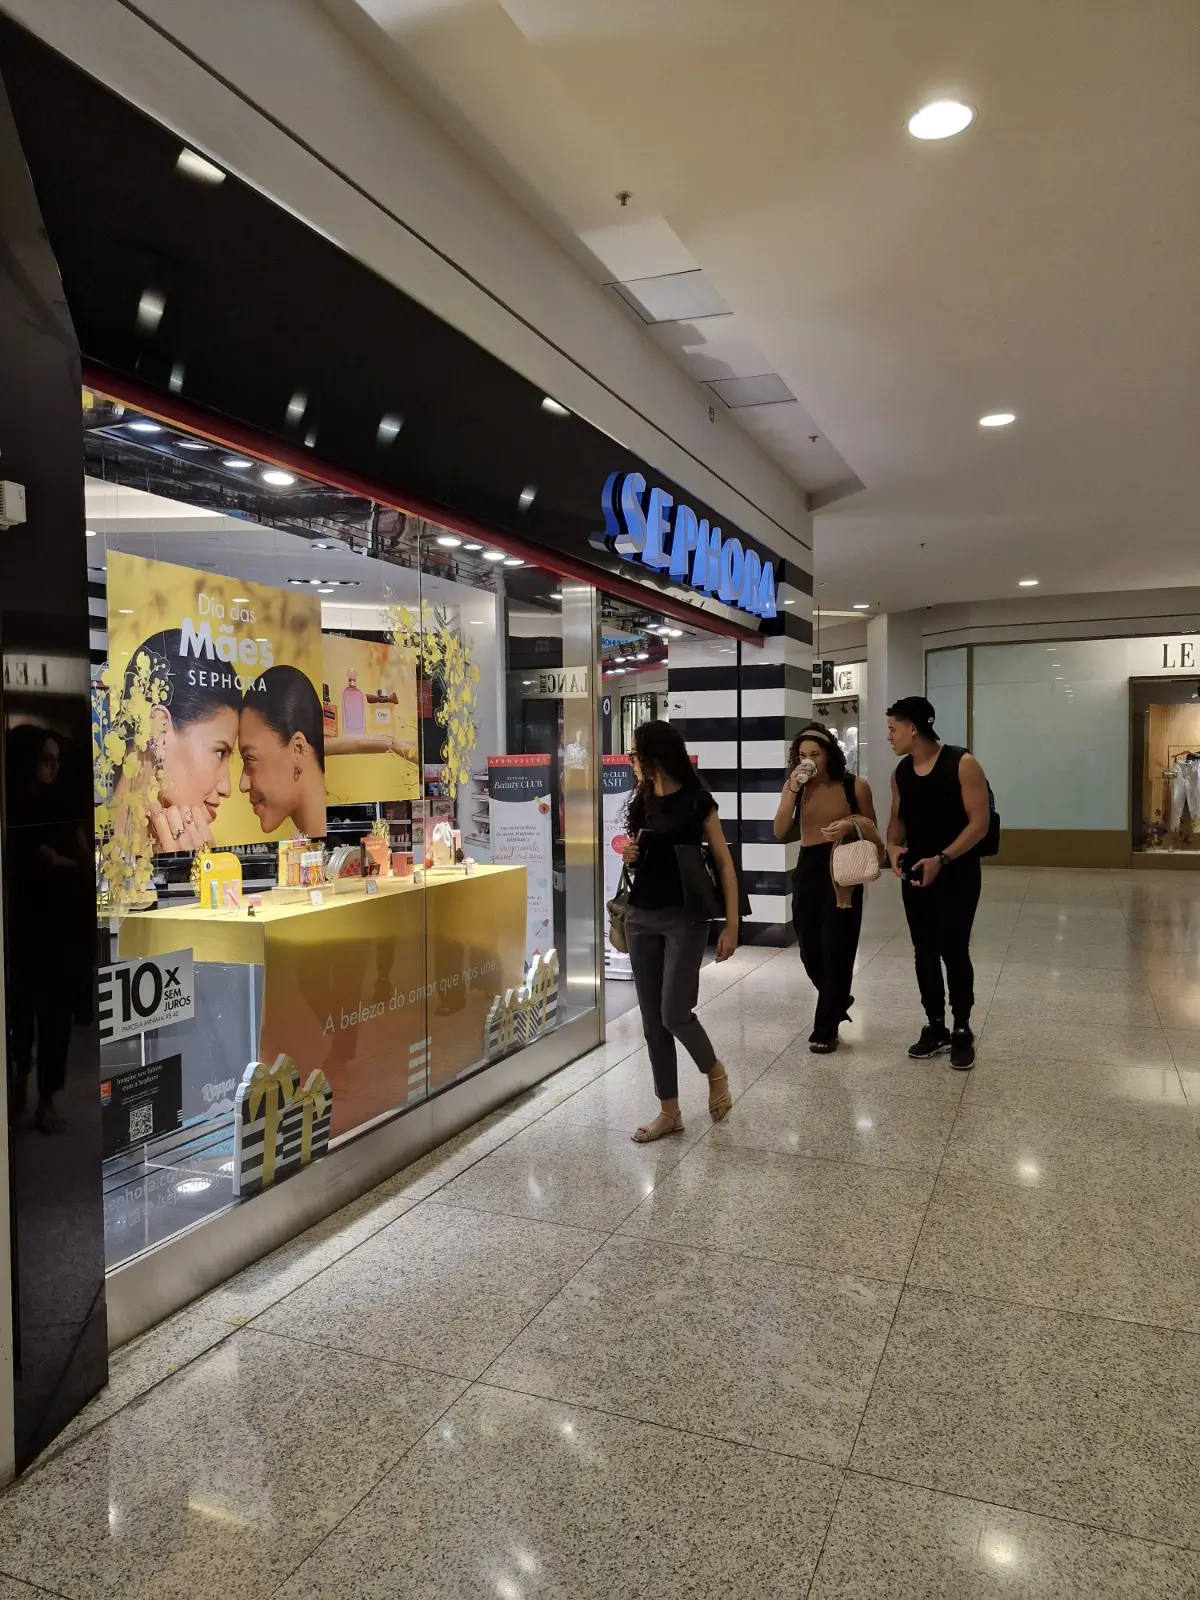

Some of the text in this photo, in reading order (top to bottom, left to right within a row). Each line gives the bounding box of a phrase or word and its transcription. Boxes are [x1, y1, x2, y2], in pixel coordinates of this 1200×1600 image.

[613, 472, 777, 618] SEPHORA
[198, 593, 257, 624] Dia das
[179, 616, 275, 669] Mães
[1161, 642, 1195, 669] LE
[188, 669, 267, 693] SEPHORA
[494, 780, 543, 791] Beauty CLUB
[164, 987, 182, 1001] SEM
[164, 995, 192, 1012] JUROS
[322, 958, 497, 1036] A beleza do amor que nos une
[138, 1075, 159, 1086] Sephora
[202, 1077, 237, 1102] Rappi
